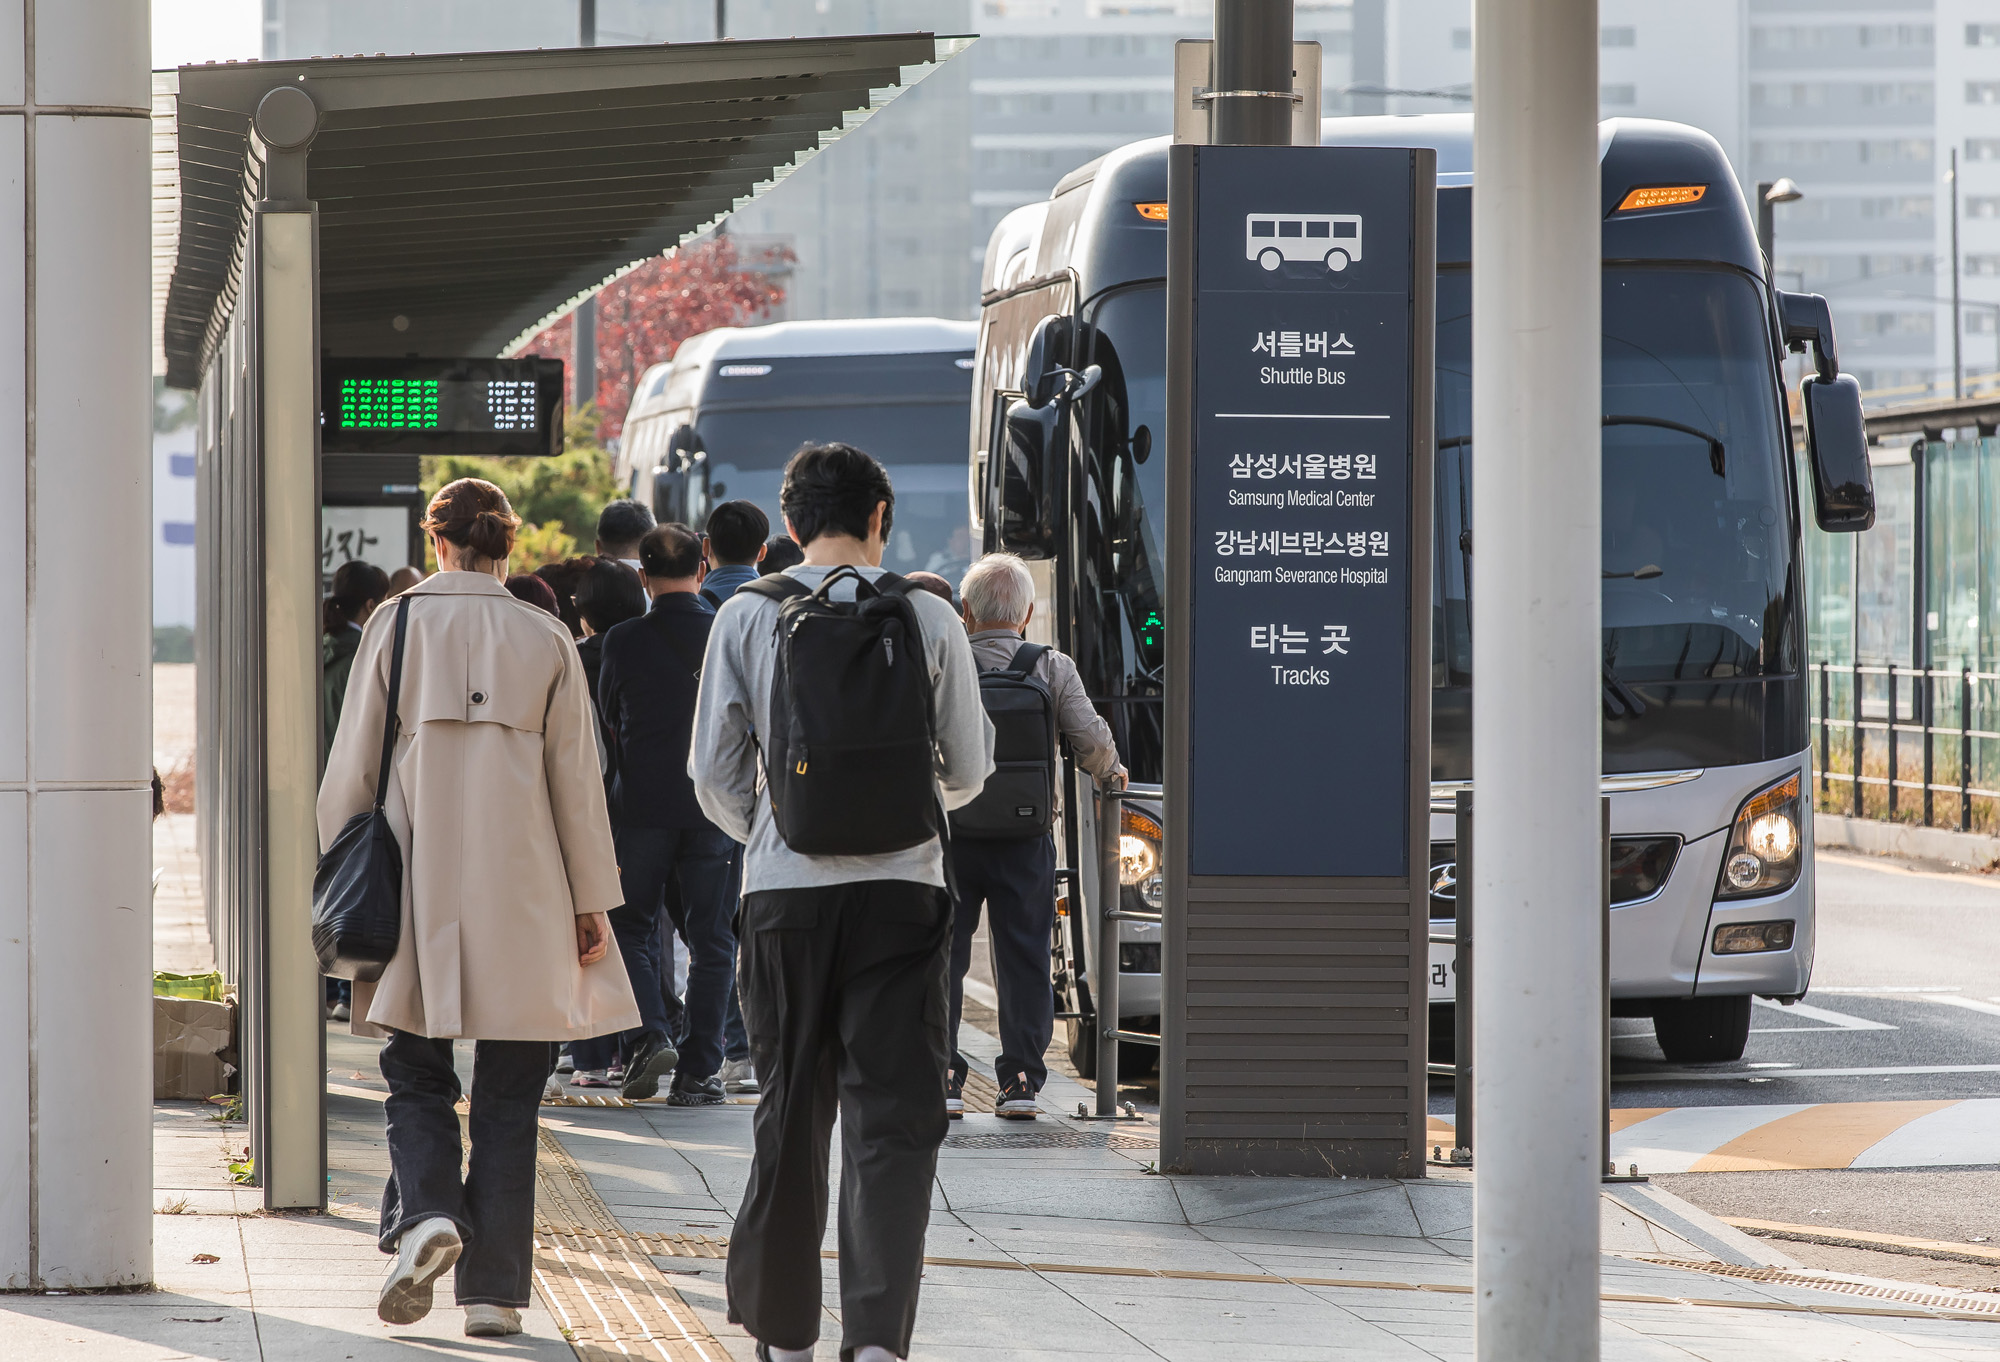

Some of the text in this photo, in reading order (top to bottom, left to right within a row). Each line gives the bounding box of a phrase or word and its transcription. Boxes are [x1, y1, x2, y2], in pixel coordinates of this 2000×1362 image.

[1251, 330, 1356, 358] 셔틀버스
[1260, 367, 1346, 385] Shuttle Bus
[1228, 453, 1377, 480] 삼성서울병원
[1228, 489, 1376, 509] Samsung Medical Center
[1214, 529, 1389, 558] 강남세브란스병원
[1214, 566, 1388, 588] Gangnam Severance Hospital
[1250, 623, 1351, 655] 타는 곳
[1271, 666, 1330, 686] Tracks
